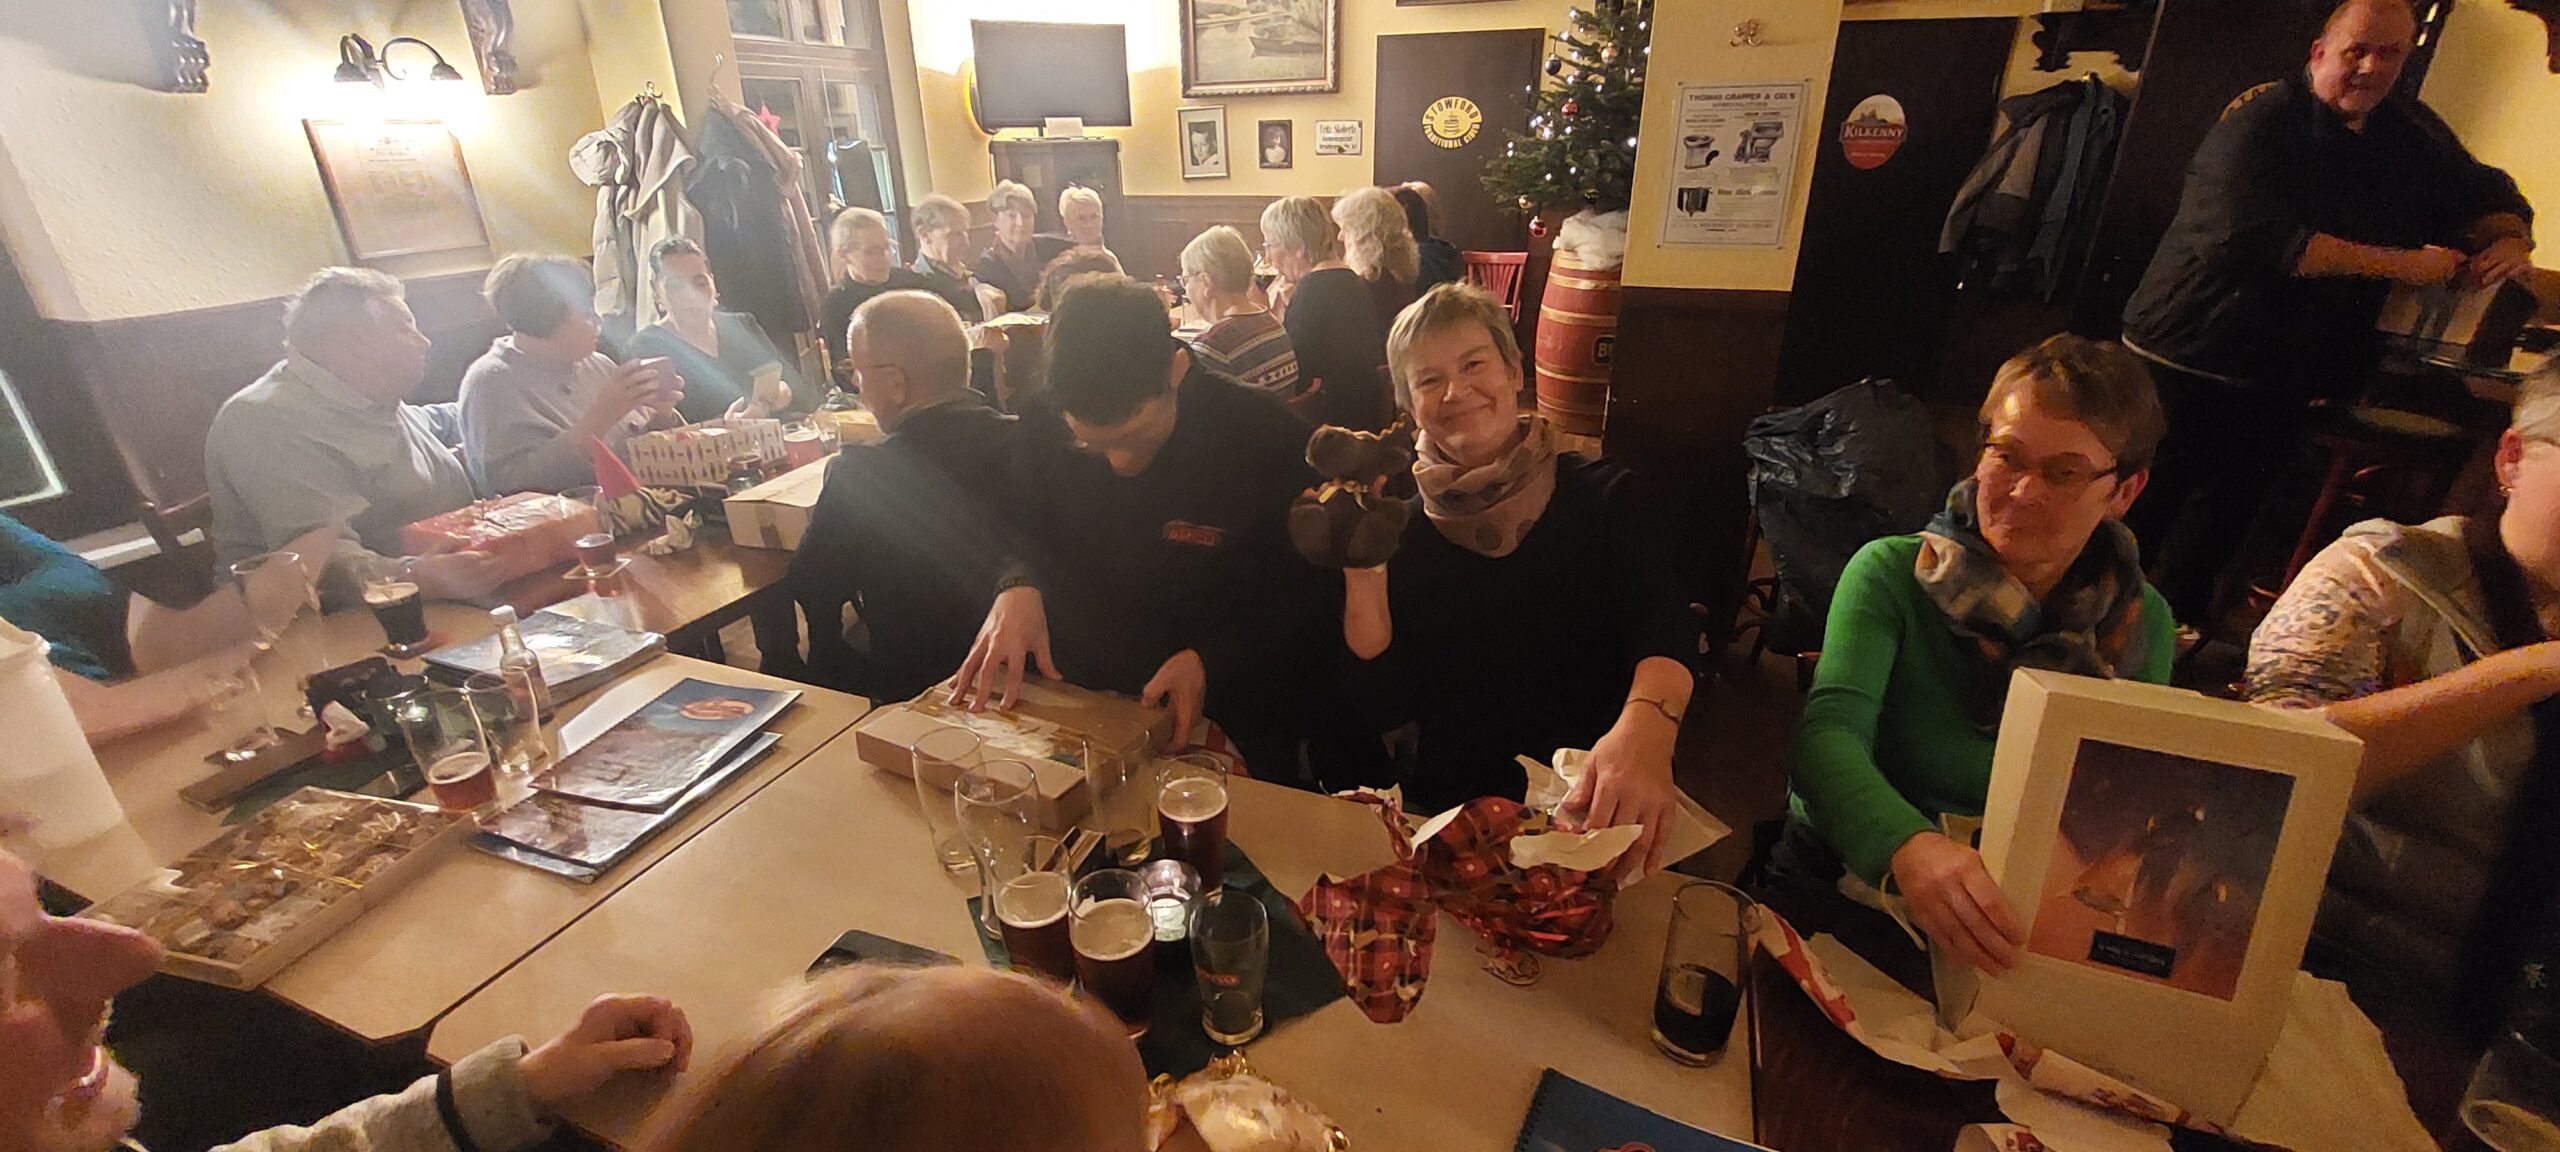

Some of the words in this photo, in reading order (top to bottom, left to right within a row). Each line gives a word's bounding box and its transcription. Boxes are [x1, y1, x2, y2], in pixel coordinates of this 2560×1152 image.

[1425, 98, 1479, 122] STOWFORD
[1423, 125, 1463, 148] TRADITIONAL
[1844, 125, 1904, 138] KILKENNY
